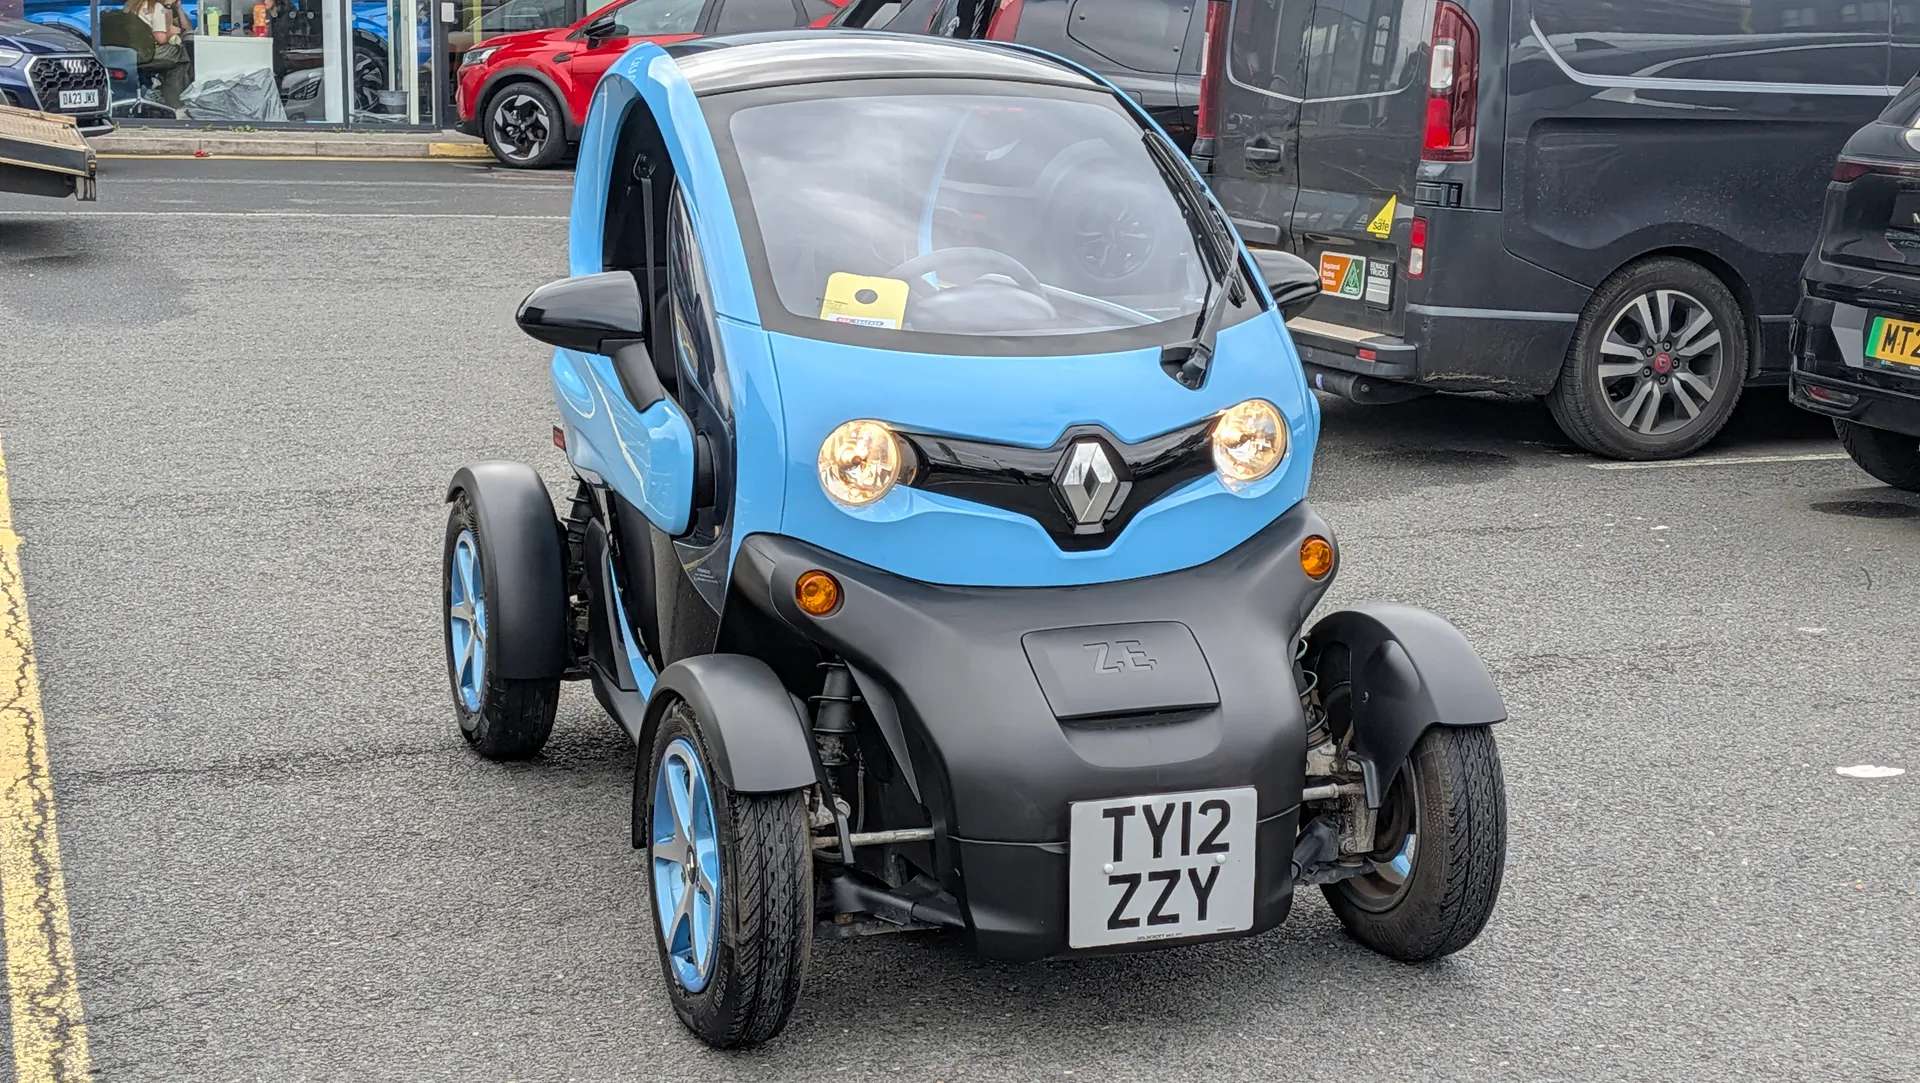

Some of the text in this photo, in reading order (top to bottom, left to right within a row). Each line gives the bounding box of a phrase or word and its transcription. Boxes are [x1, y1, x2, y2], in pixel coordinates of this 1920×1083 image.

[1373, 219, 1390, 232] safe
[1102, 799, 1231, 862] TY12
[1107, 866, 1220, 930] ZZY
